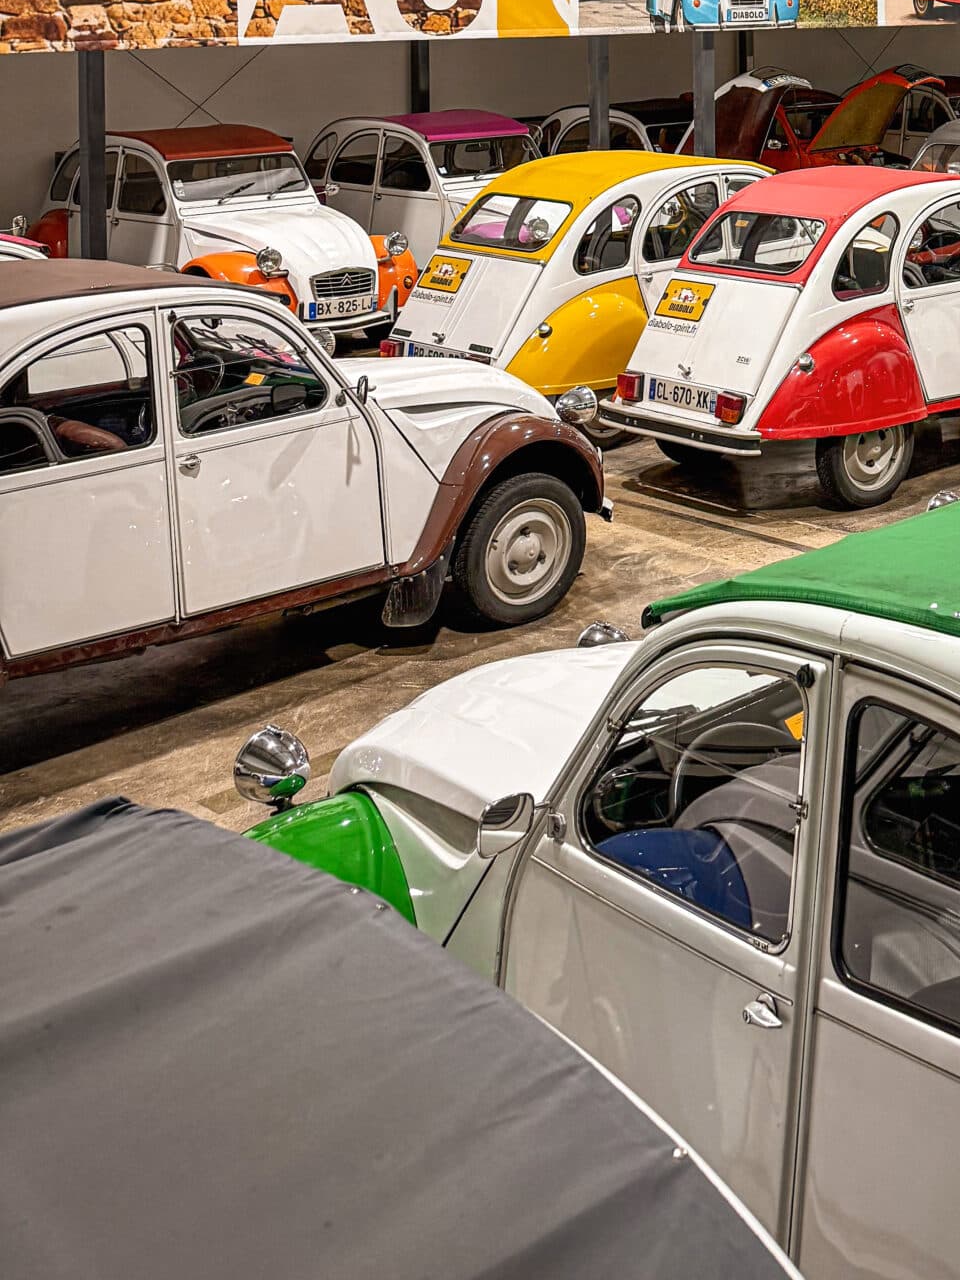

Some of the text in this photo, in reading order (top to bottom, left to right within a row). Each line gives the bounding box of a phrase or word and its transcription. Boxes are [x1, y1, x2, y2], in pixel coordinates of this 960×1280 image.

[732, 10, 764, 19] DIABOLO
[668, 302, 695, 314] DIABOLO
[648, 318, 698, 335] diabolo-spirit.fr
